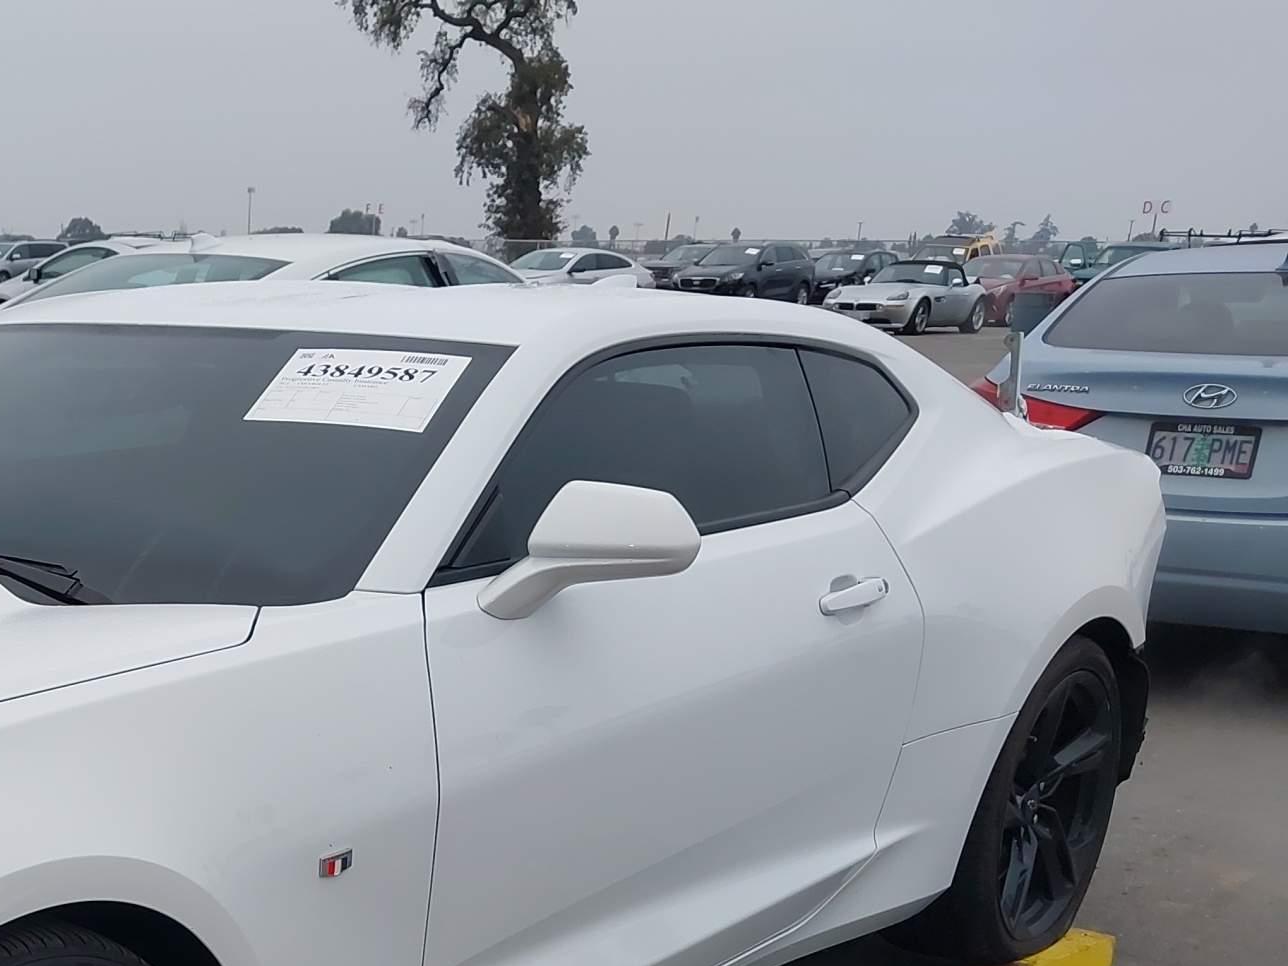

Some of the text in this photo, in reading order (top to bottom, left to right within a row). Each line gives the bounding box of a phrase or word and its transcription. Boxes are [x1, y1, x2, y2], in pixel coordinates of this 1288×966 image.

[1142, 200, 1170, 214] D C
[296, 363, 438, 384] 43849587
[1026, 383, 1090, 393] ELANTRA
[1192, 424, 1212, 433] AUTO
[1213, 425, 1235, 434] SALES
[1151, 435, 1253, 466] 617 PME
